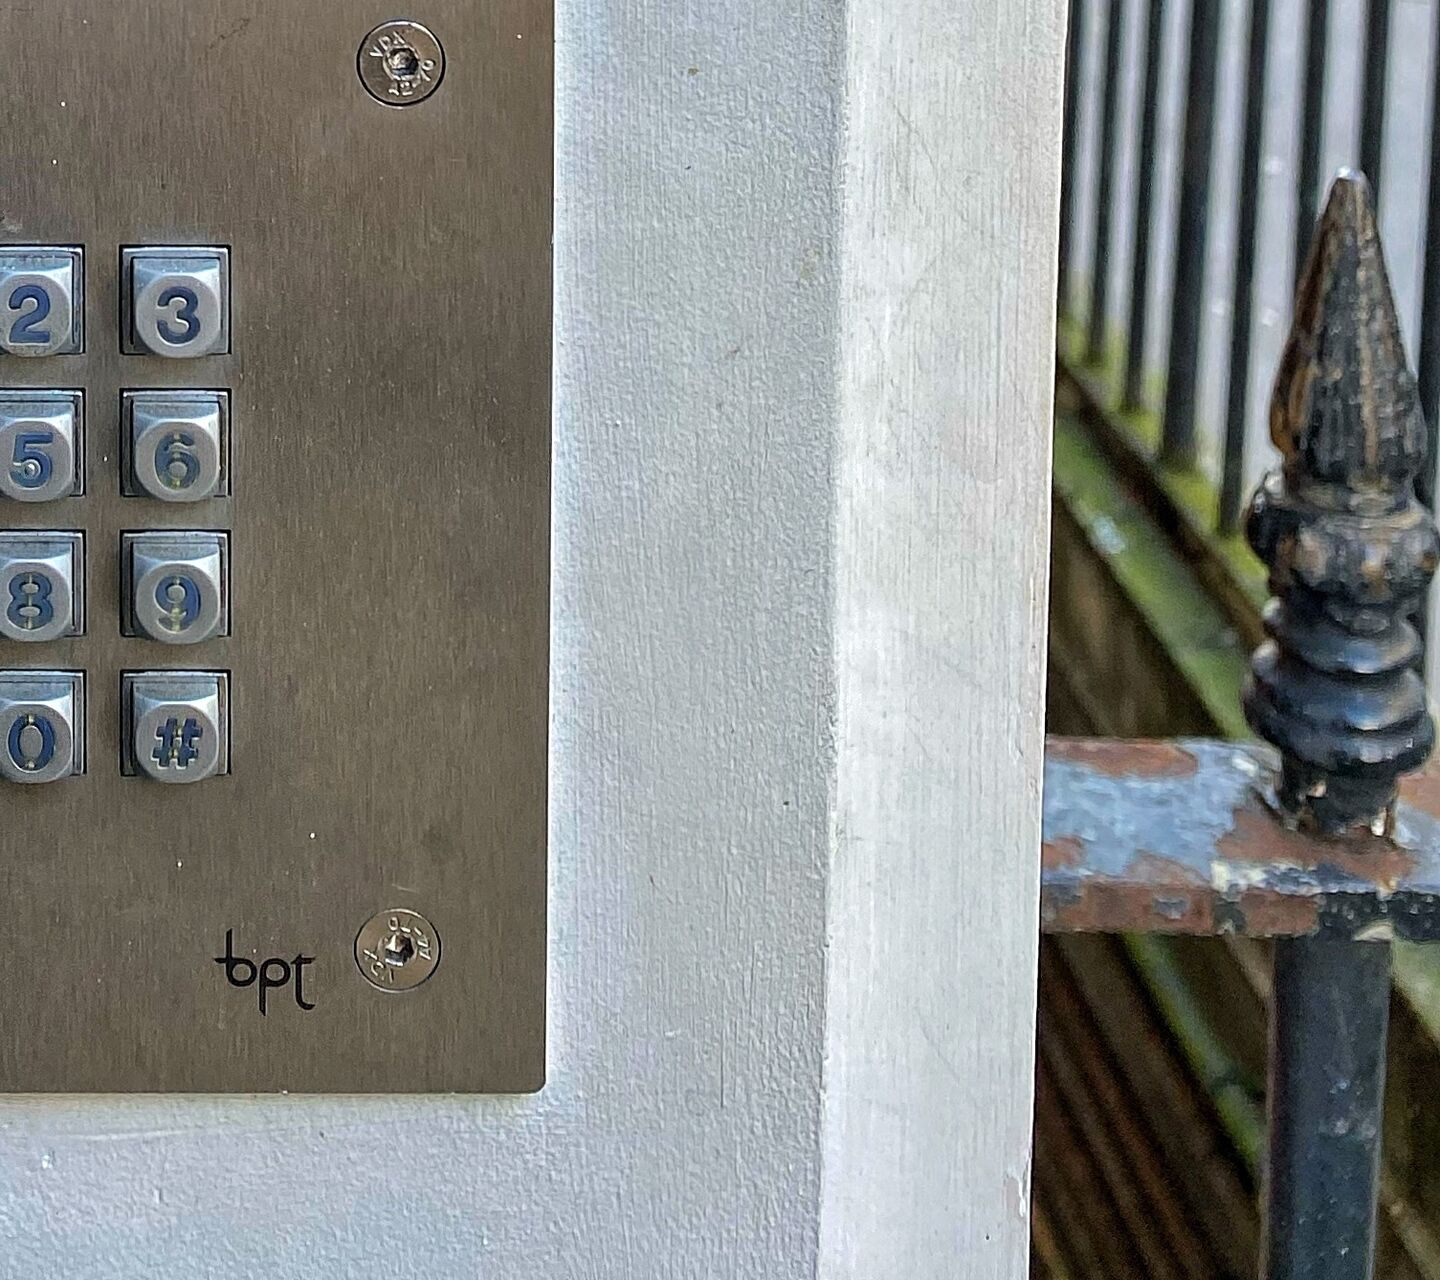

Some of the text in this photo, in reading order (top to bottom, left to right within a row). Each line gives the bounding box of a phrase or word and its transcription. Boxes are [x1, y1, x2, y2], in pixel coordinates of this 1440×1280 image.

[8, 284, 52, 344] 2
[156, 285, 200, 345] 3
[9, 431, 54, 488] 5
[154, 431, 200, 489] 6
[6, 571, 55, 630] 8
[154, 574, 202, 632] 9
[6, 712, 56, 772] 0
[152, 716, 203, 768] #
[213, 927, 317, 1017] bpt
